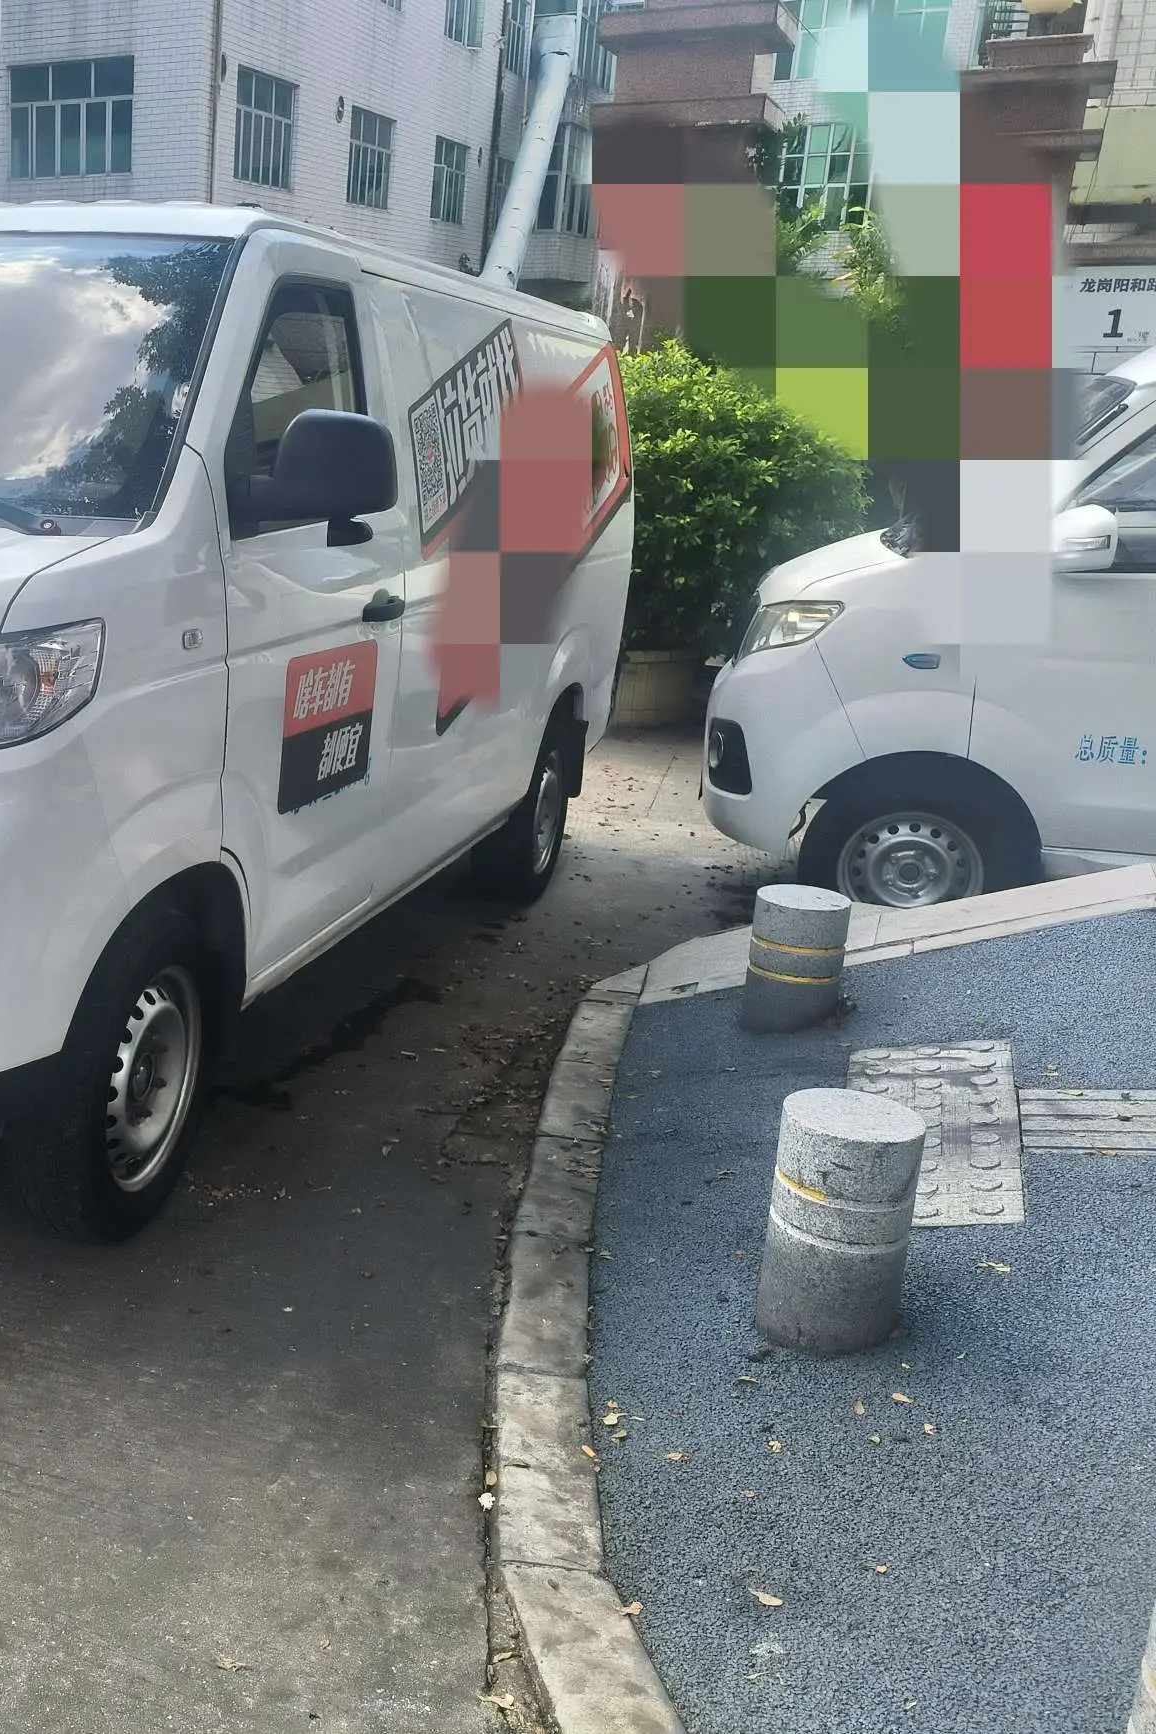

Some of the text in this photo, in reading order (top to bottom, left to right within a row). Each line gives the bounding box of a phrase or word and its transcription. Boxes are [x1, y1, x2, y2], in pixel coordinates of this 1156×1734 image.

[1103, 308, 1124, 338] 1
[317, 722, 363, 782] 都便宜
